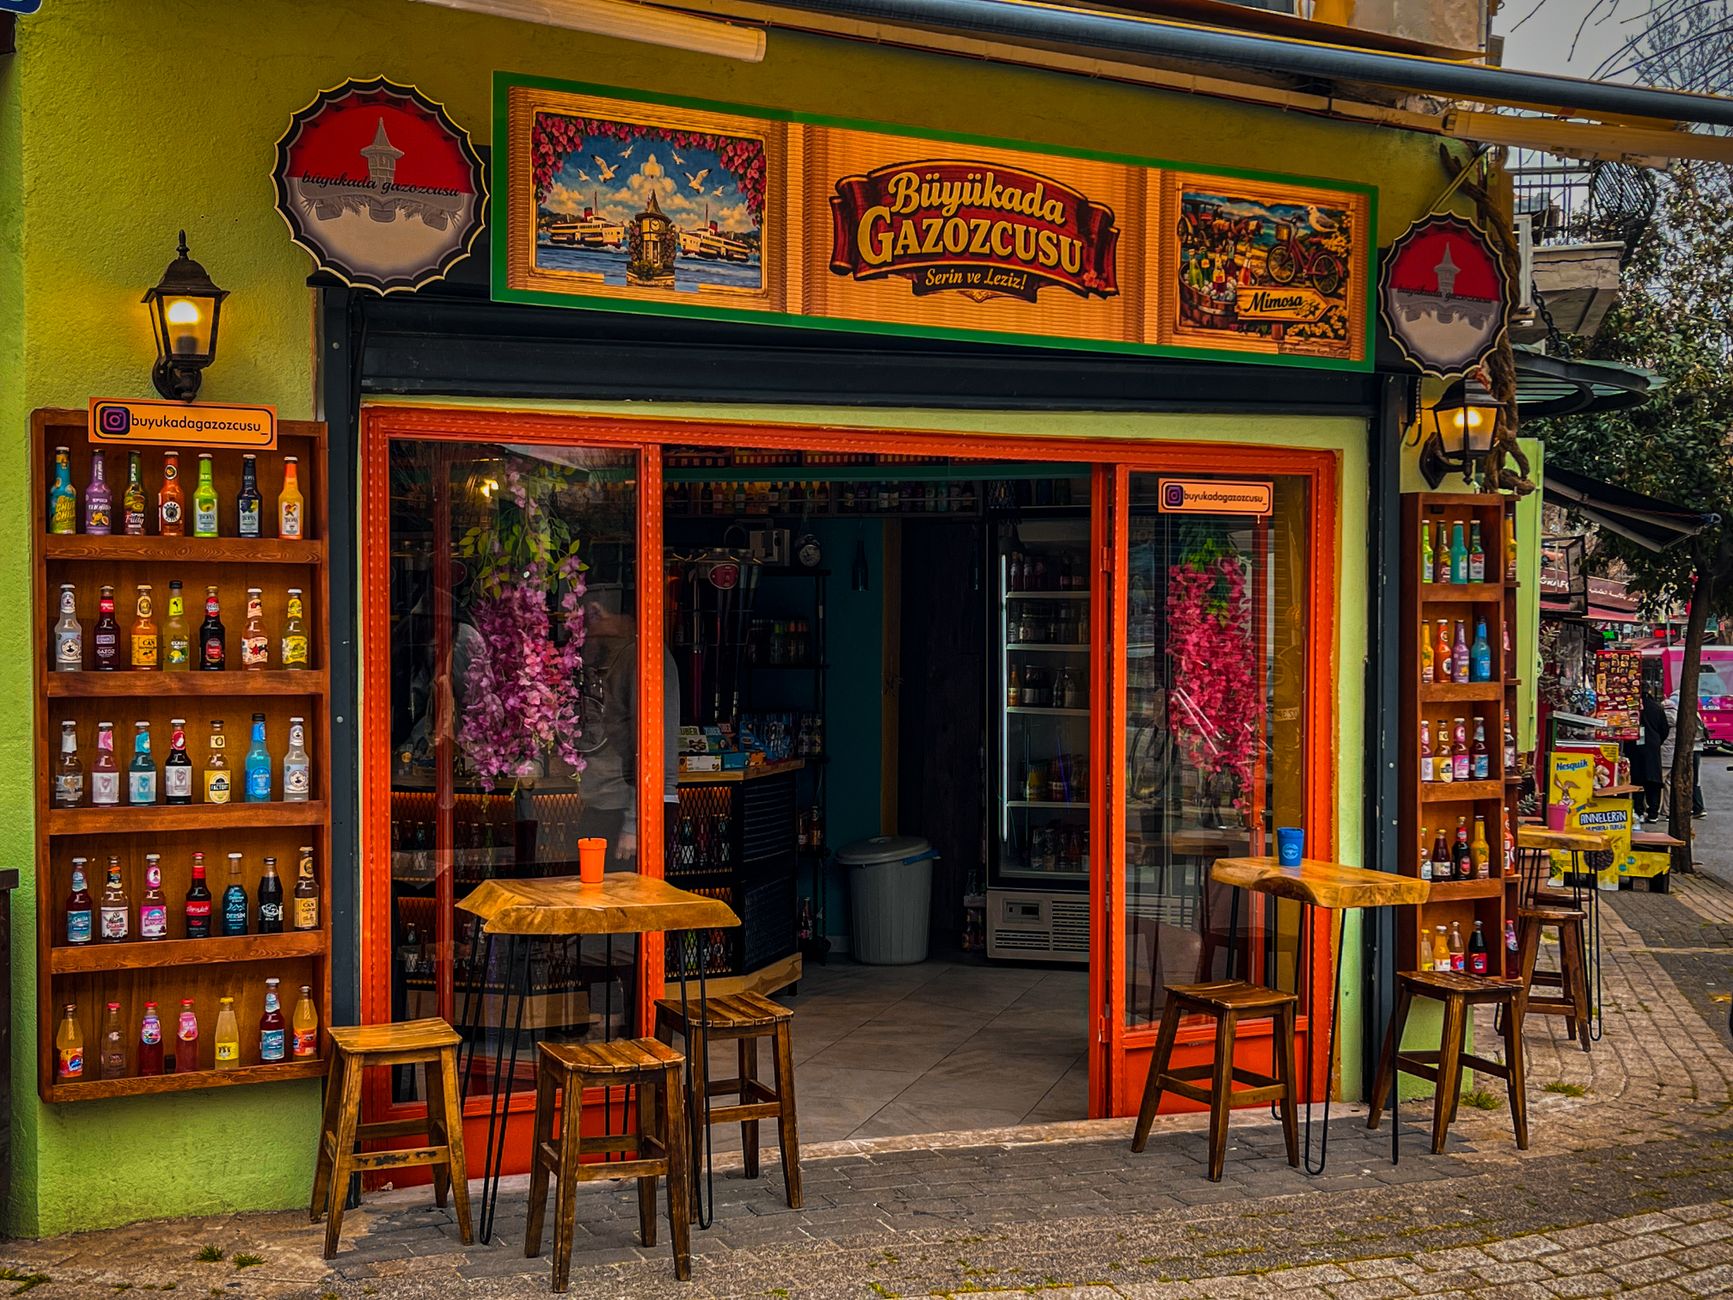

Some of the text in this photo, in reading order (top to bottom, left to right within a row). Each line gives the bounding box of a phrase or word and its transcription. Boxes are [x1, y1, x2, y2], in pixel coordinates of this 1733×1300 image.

[381, 181, 461, 198] gazozcusu
[888, 171, 1066, 224] Büyükada
[857, 206, 1084, 273] GAZOZCUSU
[925, 268, 1027, 290] Serin ve Leziz!
[1243, 290, 1304, 313] Mimosa
[131, 413, 269, 436] buyukadagazozcusu_
[1184, 490, 1268, 506] buyukadagazozcusu_
[1555, 759, 1589, 771] Nesquik
[1580, 810, 1627, 825] ANNELERİN
